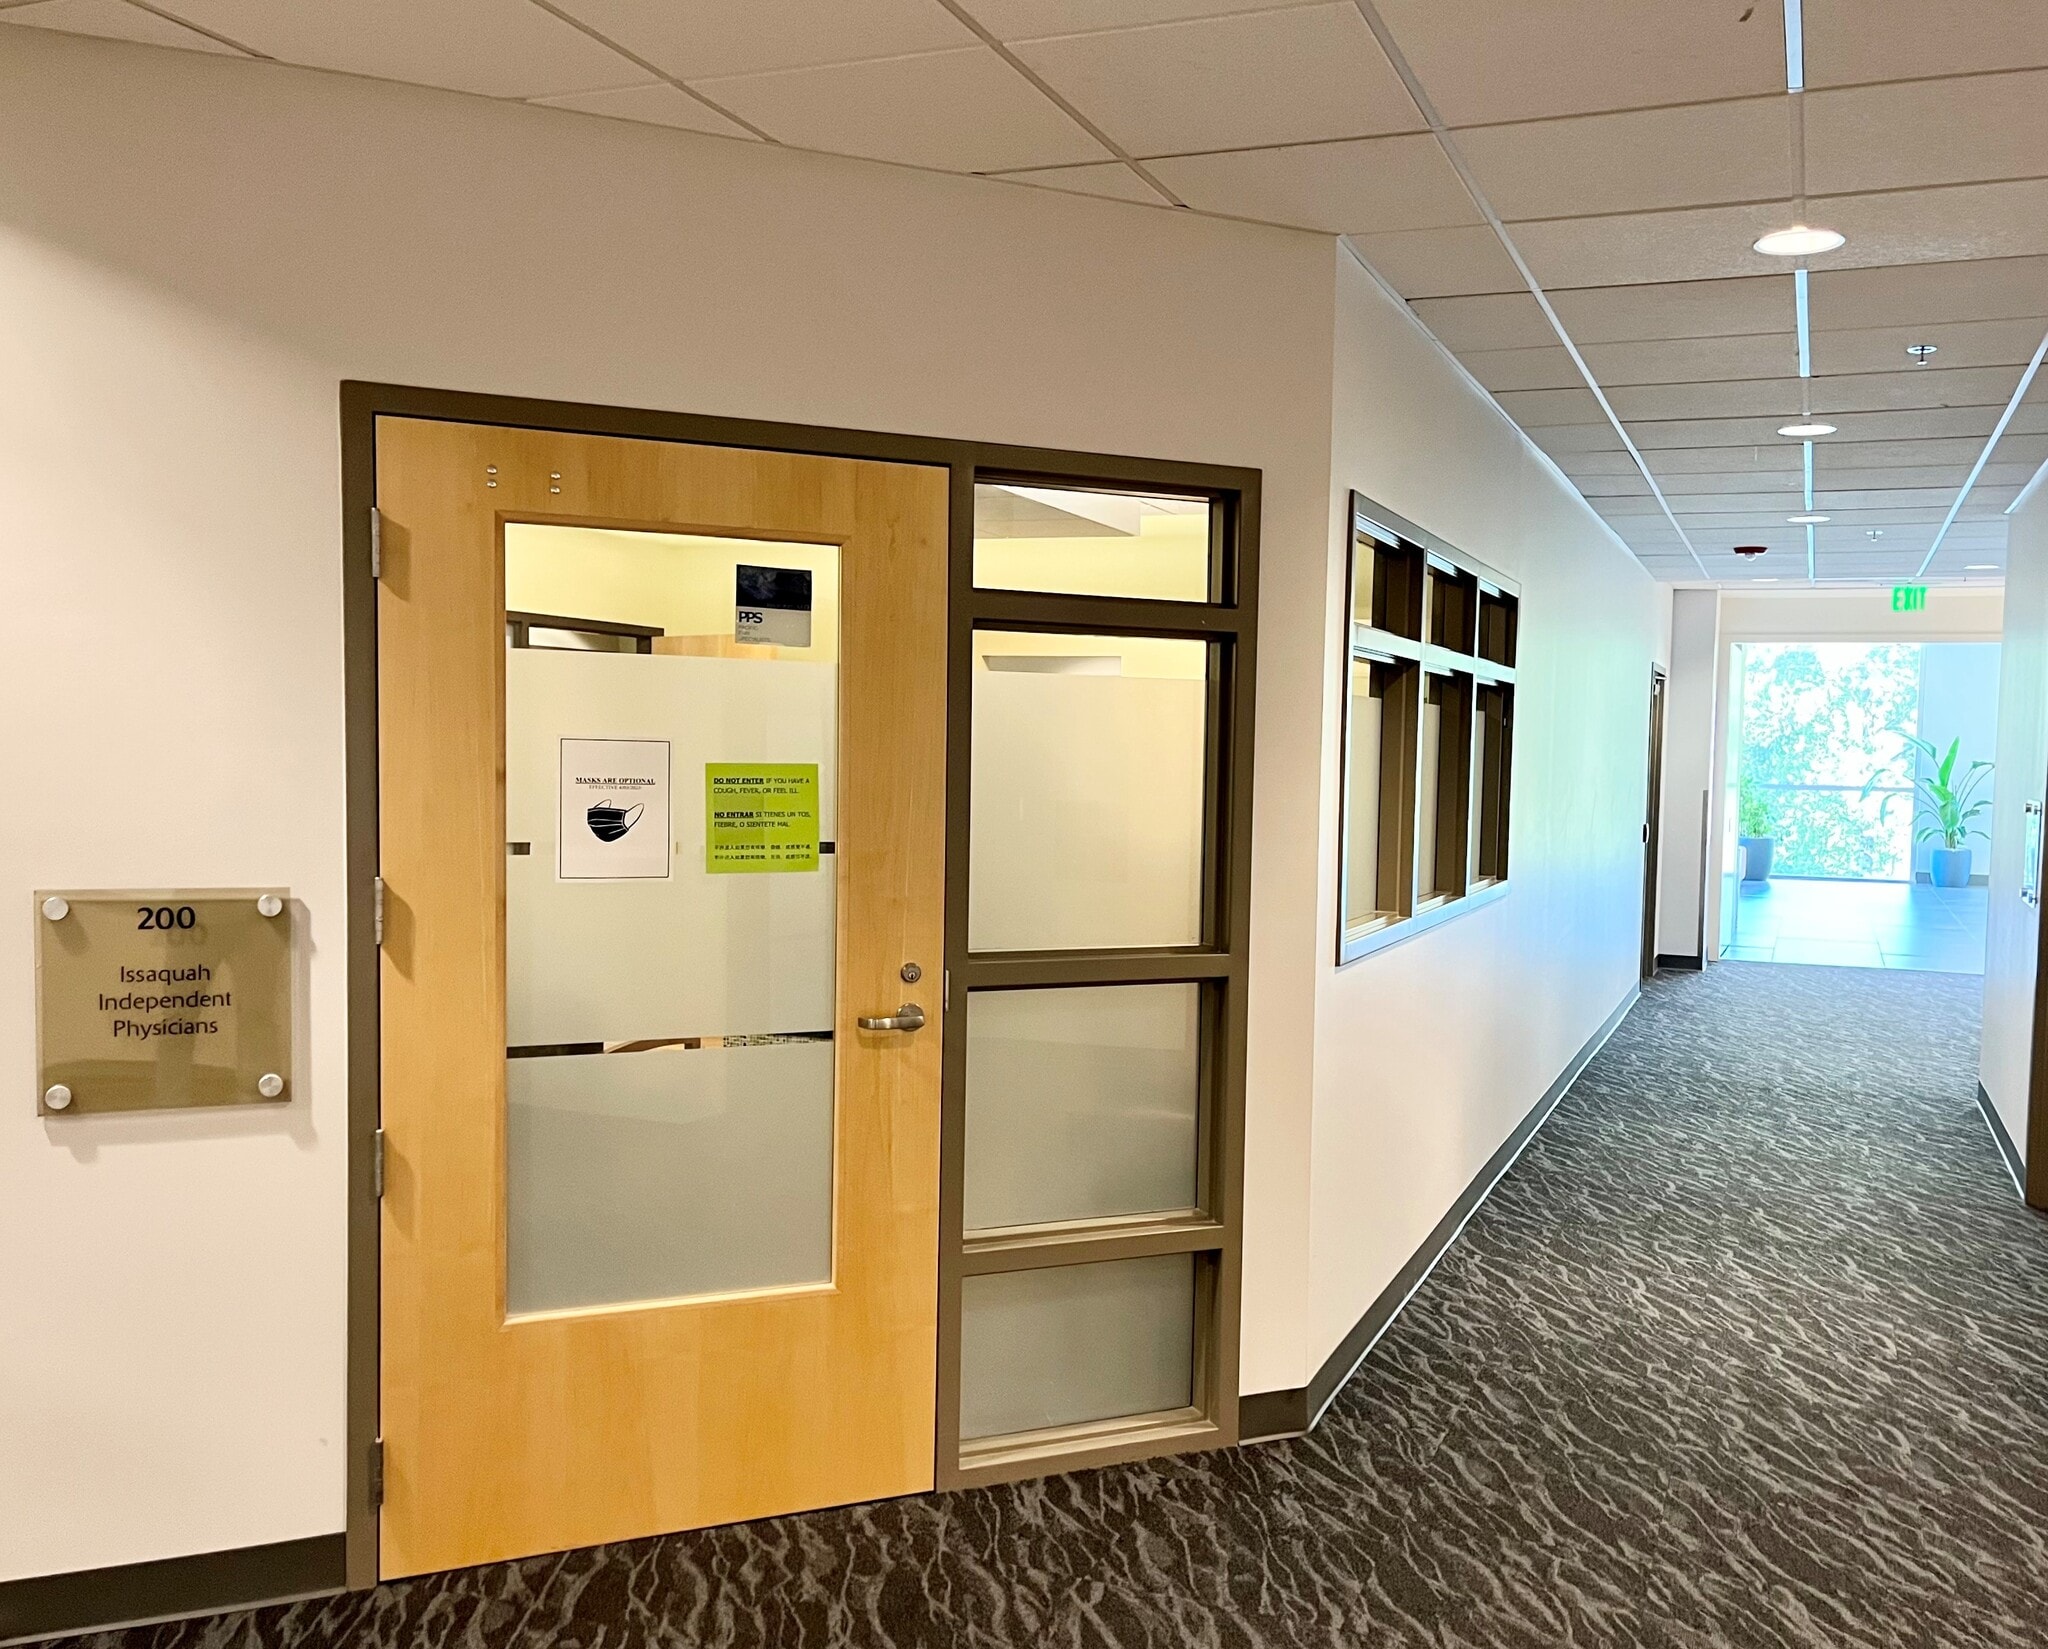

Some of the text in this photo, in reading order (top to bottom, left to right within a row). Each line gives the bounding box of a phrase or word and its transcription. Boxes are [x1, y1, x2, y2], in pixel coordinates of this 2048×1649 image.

[1893, 586, 1926, 610] EXIT
[738, 611, 763, 624] PPS
[137, 906, 196, 930] 200
[120, 964, 210, 986] Issaquah
[99, 990, 231, 1013] Independent
[113, 1018, 218, 1040] Physicians
